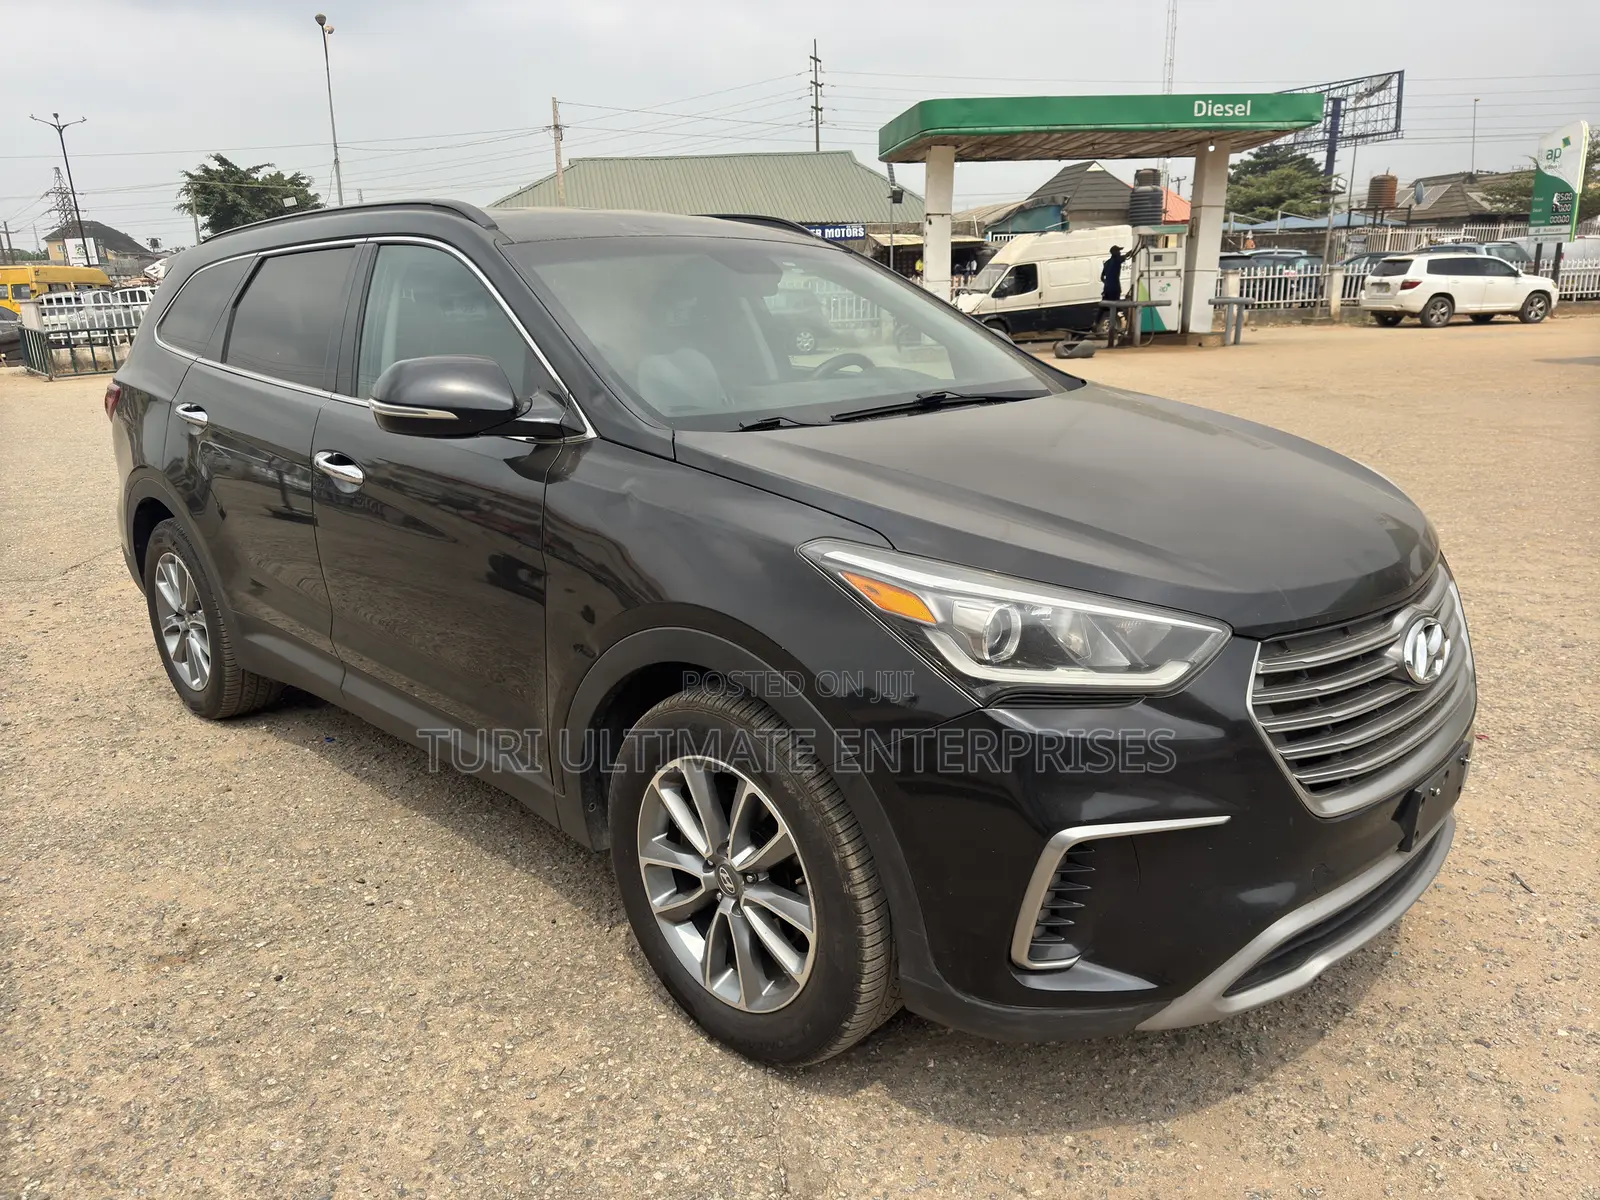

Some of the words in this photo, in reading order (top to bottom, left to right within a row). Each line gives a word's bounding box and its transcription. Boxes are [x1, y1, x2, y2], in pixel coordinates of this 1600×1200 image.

[1193, 99, 1252, 117] Diesel
[1546, 148, 1562, 162] ap
[825, 228, 864, 238] MOTORS
